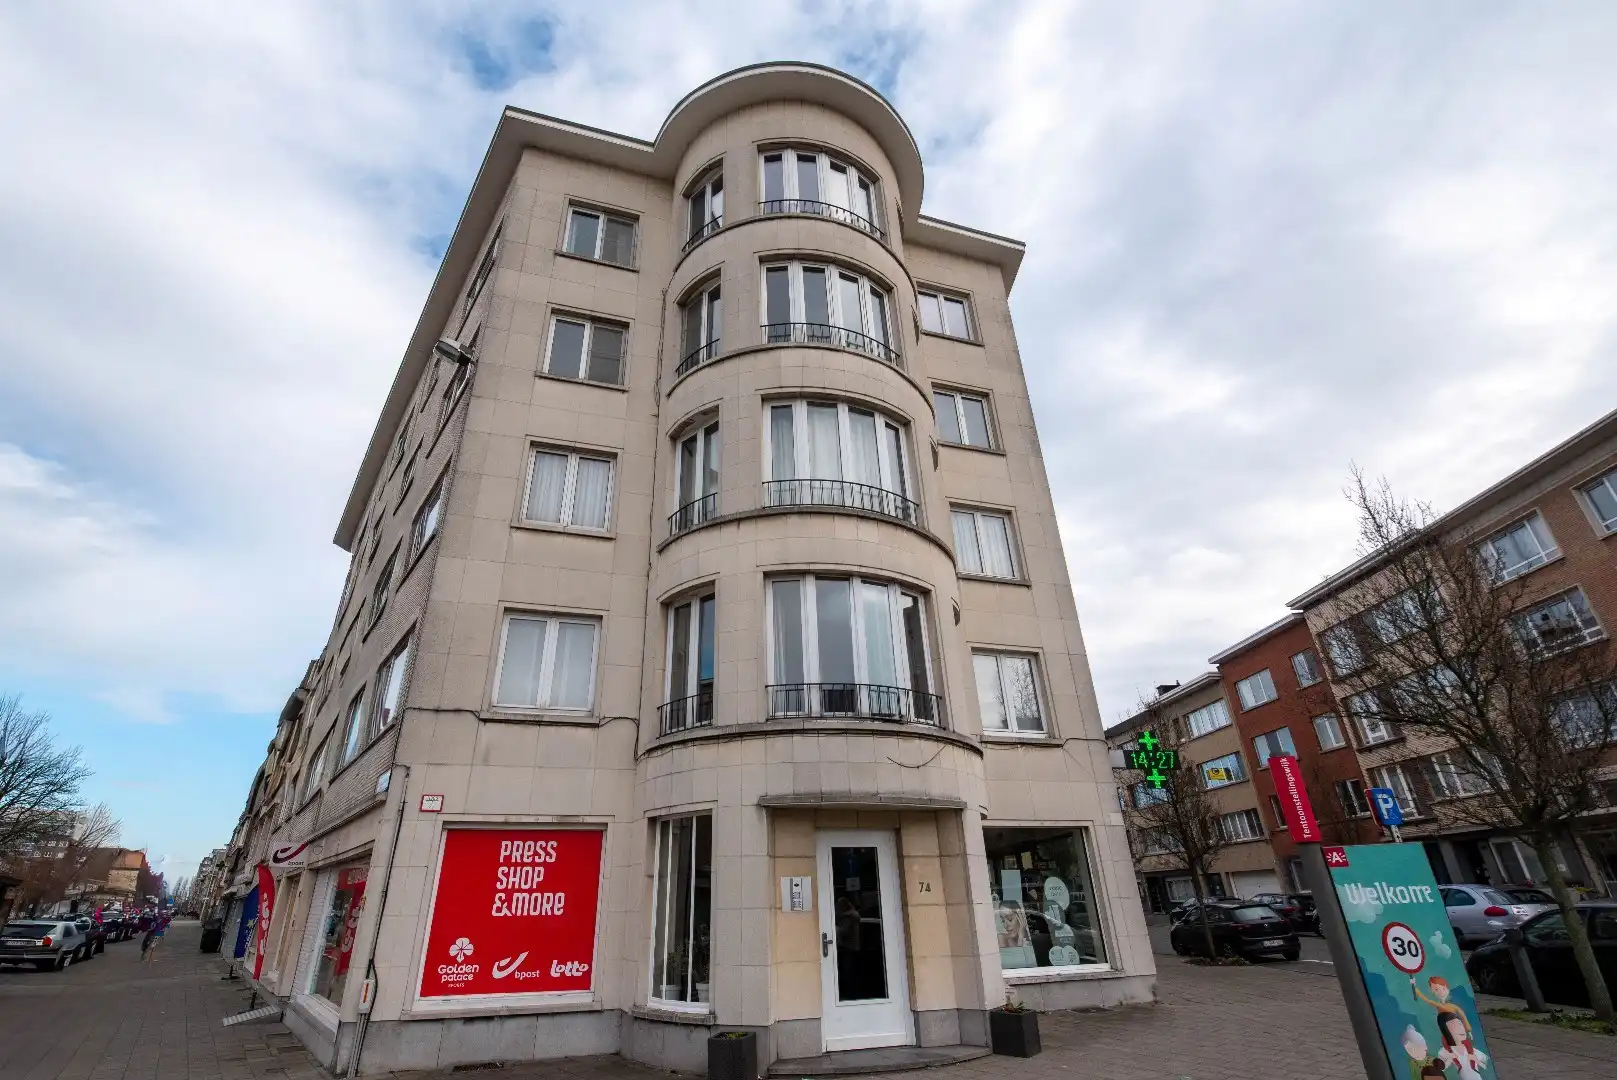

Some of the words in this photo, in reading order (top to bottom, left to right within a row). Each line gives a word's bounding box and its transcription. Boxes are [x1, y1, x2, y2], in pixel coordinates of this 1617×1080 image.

[1130, 751, 1174, 769] 14:27
[1279, 757, 1313, 839] Tentoonstellingswijk
[1376, 793, 1394, 820] P
[496, 866, 545, 890] SHOP
[918, 881, 932, 893] 74
[1391, 936, 1419, 958] 30
[437, 963, 480, 974] Golden
[514, 969, 541, 981] bpost
